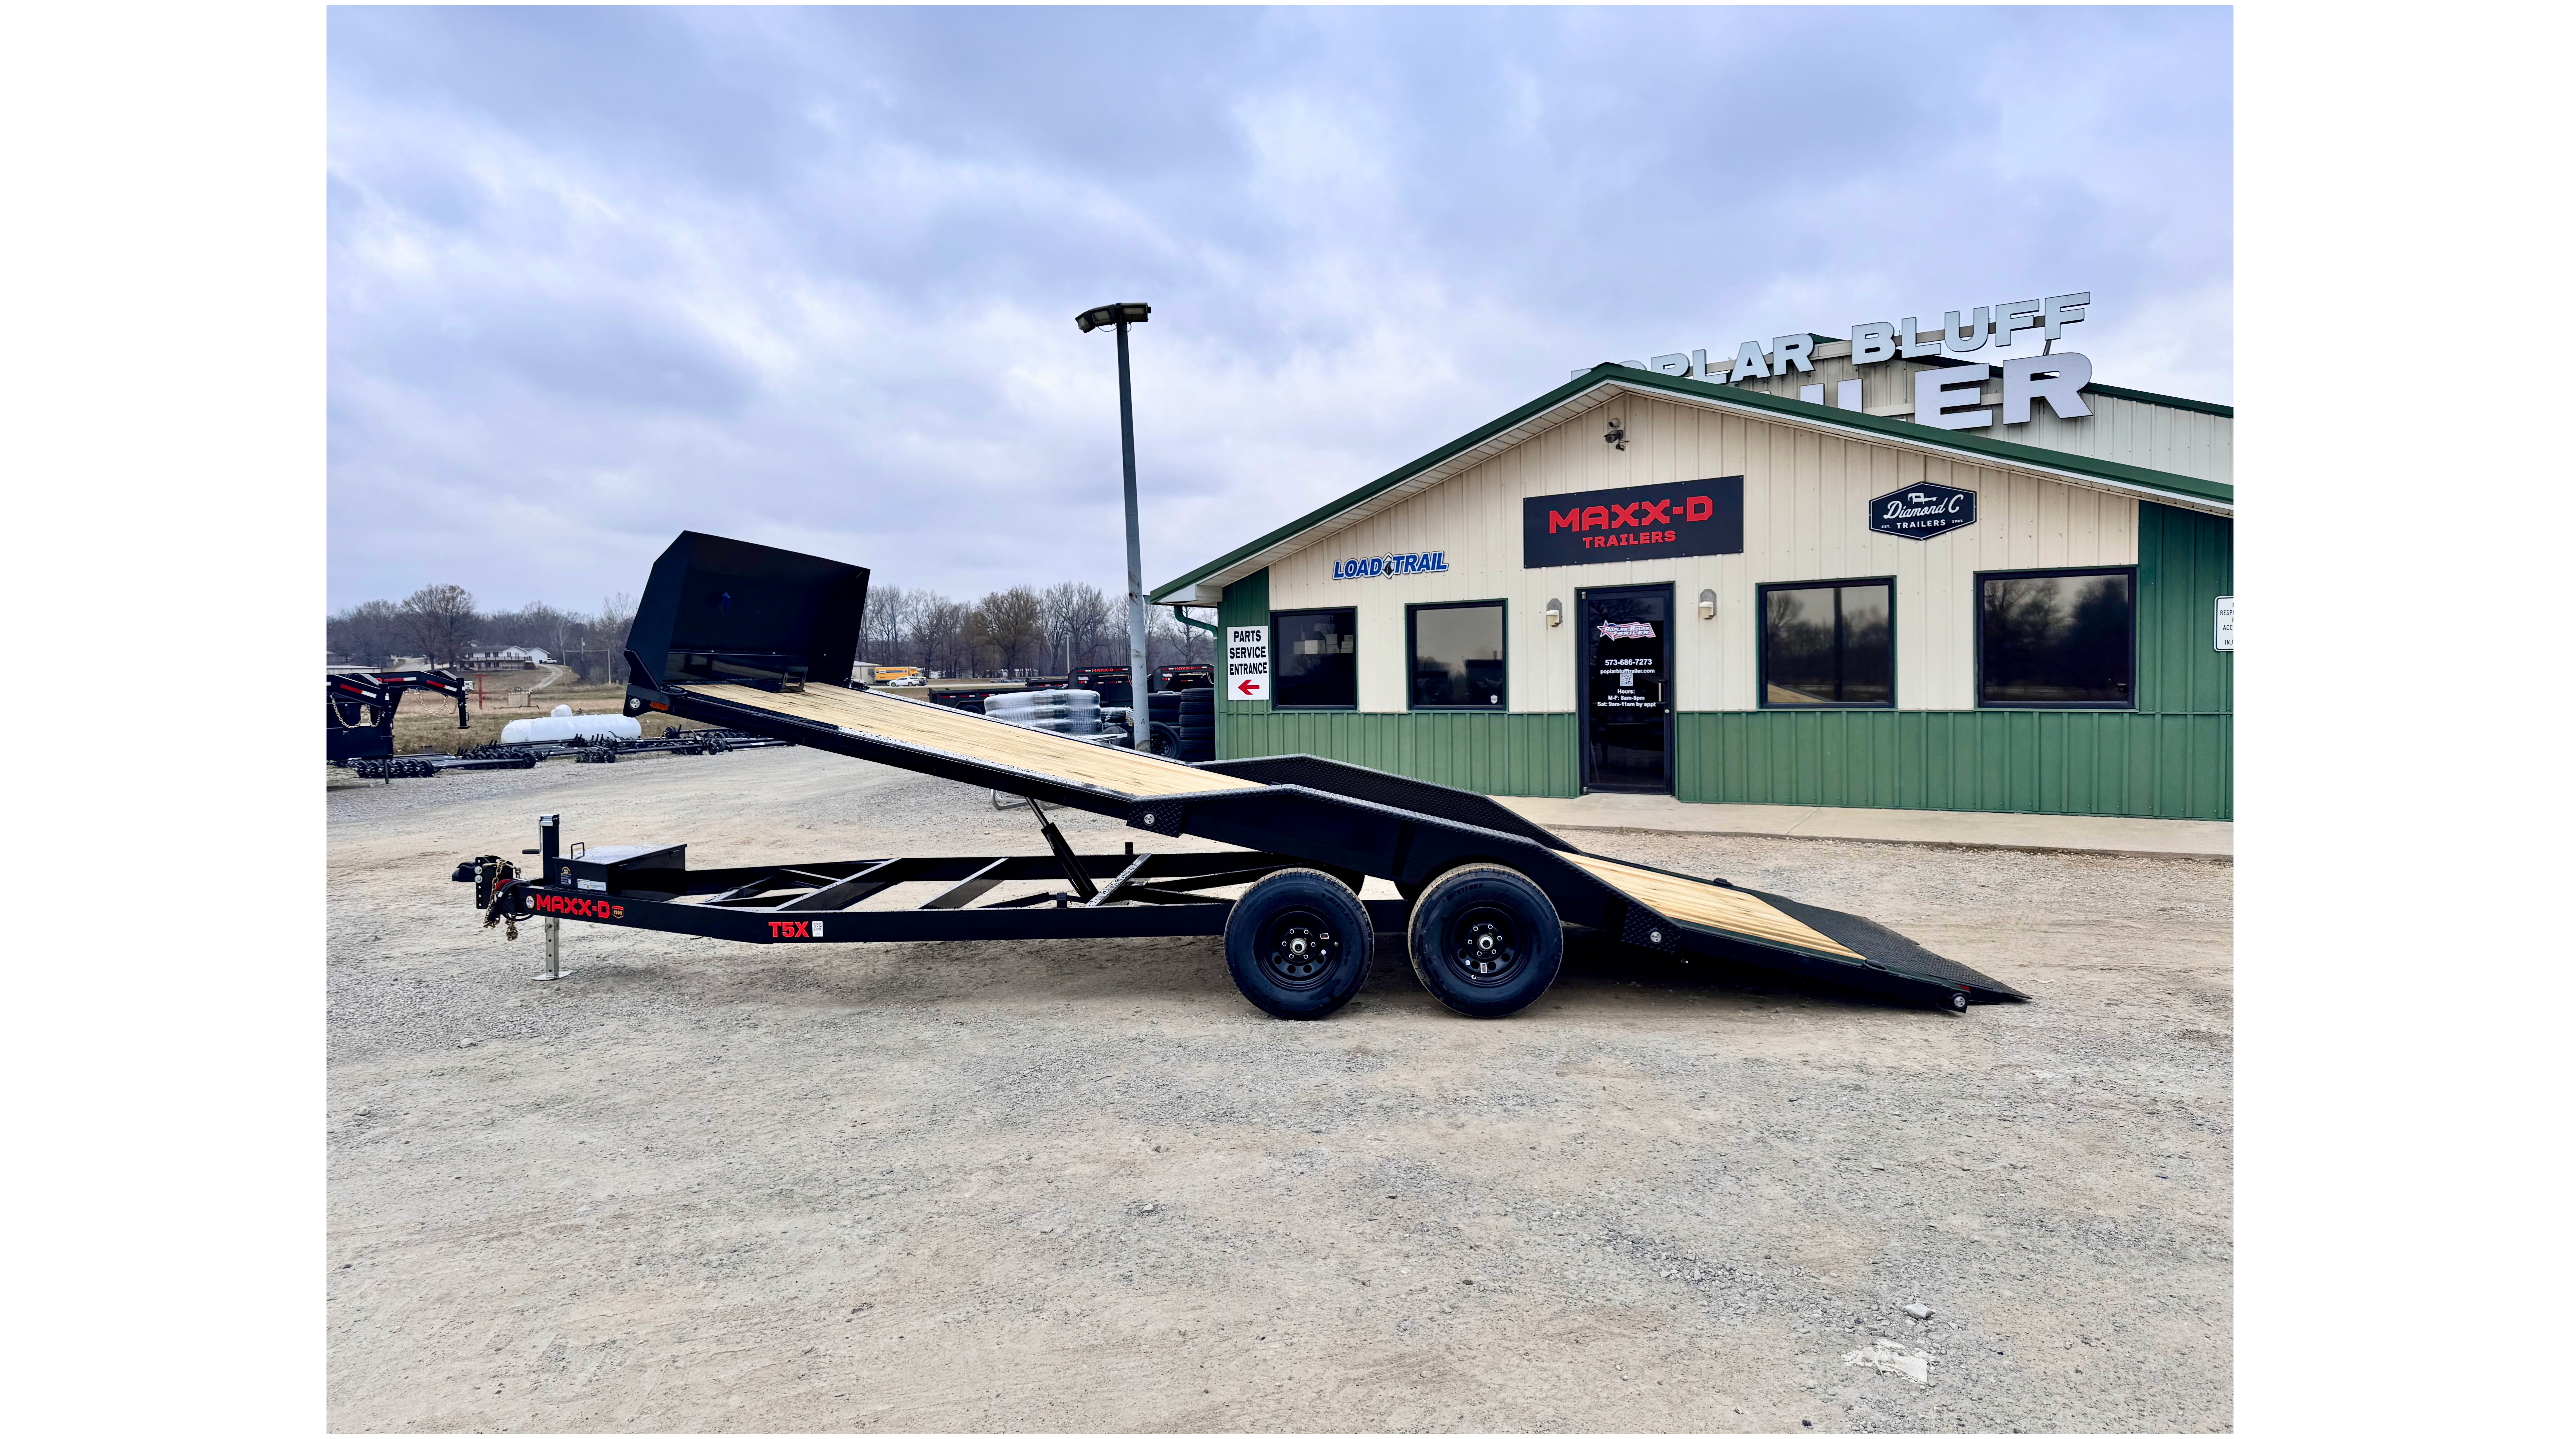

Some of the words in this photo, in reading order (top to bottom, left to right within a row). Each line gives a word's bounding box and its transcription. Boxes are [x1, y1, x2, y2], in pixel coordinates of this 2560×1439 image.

[1571, 333, 1815, 384] PLAR
[1852, 292, 2090, 365] BLUFF
[1550, 495, 1713, 534] MAXX-D
[1882, 497, 1948, 519] Diamond
[1948, 494, 1964, 513] C
[1896, 519, 1946, 529] TRAILERS
[1582, 530, 1676, 548] TRAILERS
[1332, 557, 1382, 580] LOAD
[1392, 550, 1449, 575] TRAIL
[1233, 630, 1262, 642] PARTS
[1230, 646, 1267, 659] SERVICE
[1230, 662, 1268, 675] ENTRANCE
[536, 893, 611, 919] MAXX-D
[768, 920, 810, 938] T5X
